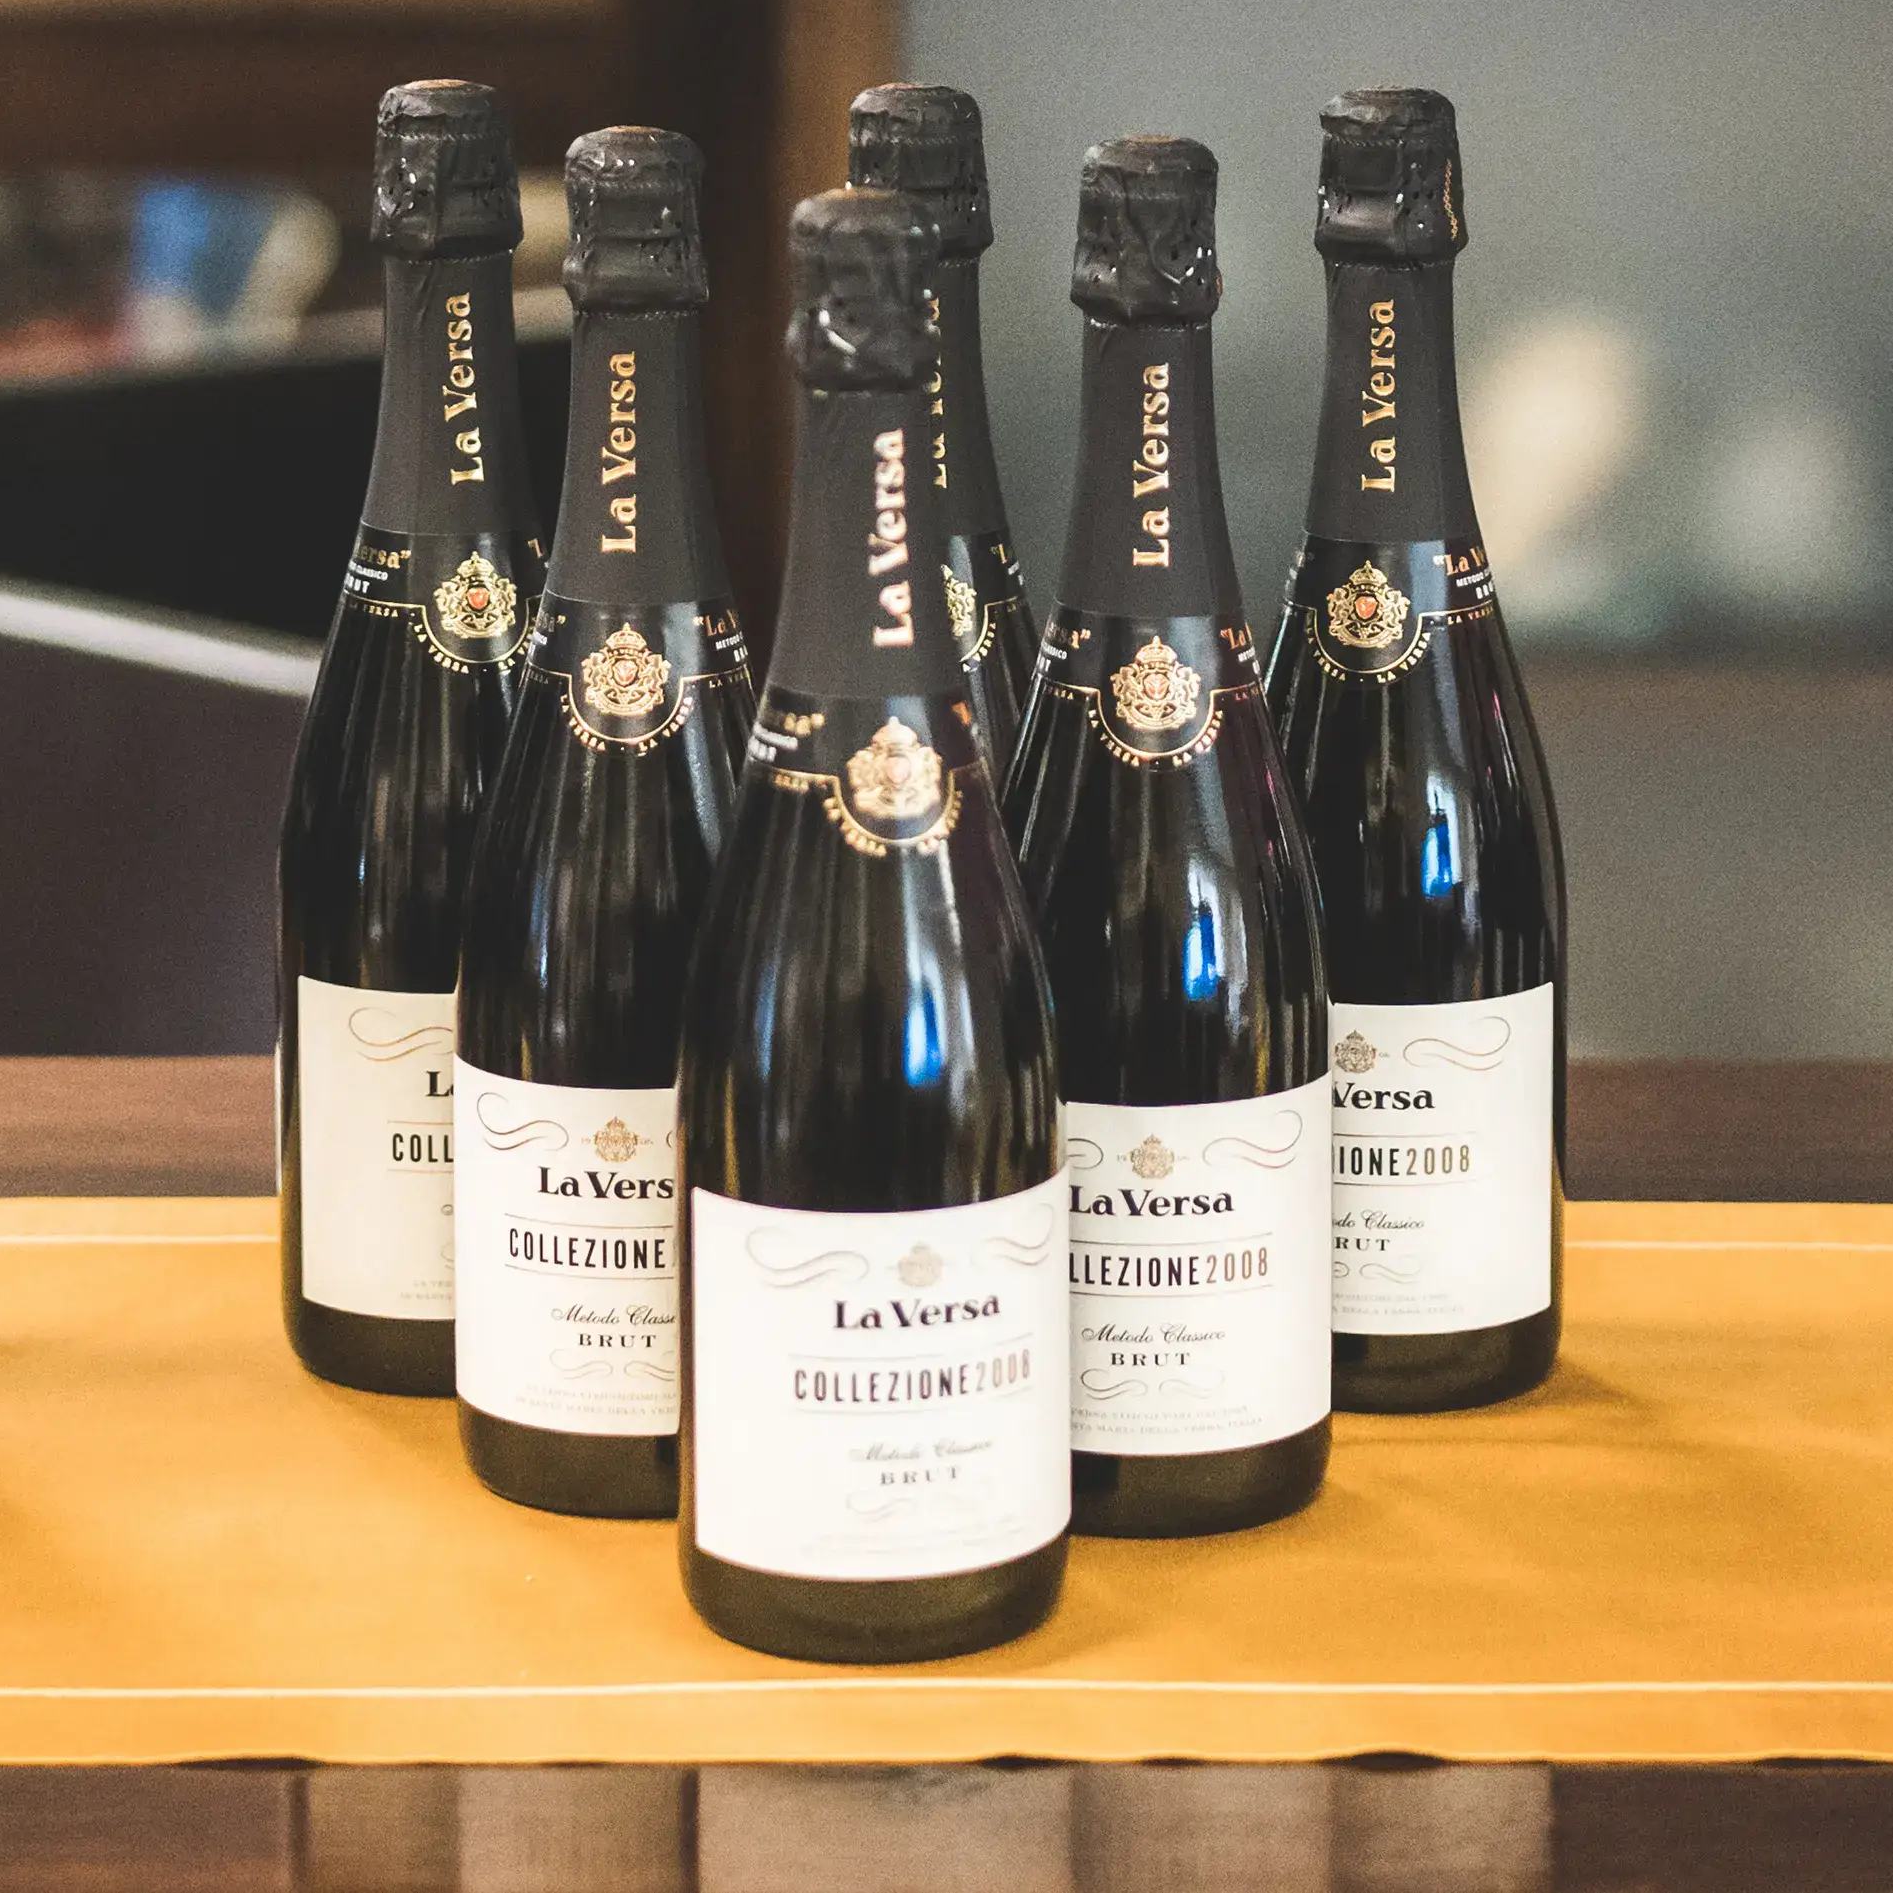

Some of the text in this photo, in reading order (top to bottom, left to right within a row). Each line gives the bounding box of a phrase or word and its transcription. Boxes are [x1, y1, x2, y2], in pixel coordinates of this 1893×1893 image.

[443, 291, 484, 486] La Versa
[1362, 298, 1395, 493] La Versa
[601, 351, 636, 553] La Versa
[1132, 362, 1169, 569] La Versa
[867, 427, 914, 648] La Versa
[1333, 1082, 1435, 1110] Versa
[538, 1166, 675, 1199] La Vers
[1069, 1185, 1234, 1217] La Versa
[1360, 1209, 1424, 1230] Classico
[509, 1228, 675, 1269] COLLEZIONE
[551, 1304, 620, 1324] Metodo
[833, 1294, 1000, 1331] La Versa
[579, 1333, 656, 1348] BRUT
[1081, 1323, 1226, 1344] Metodo Classico
[1111, 1353, 1190, 1366] BRUT
[880, 1466, 959, 1485] BRUT
